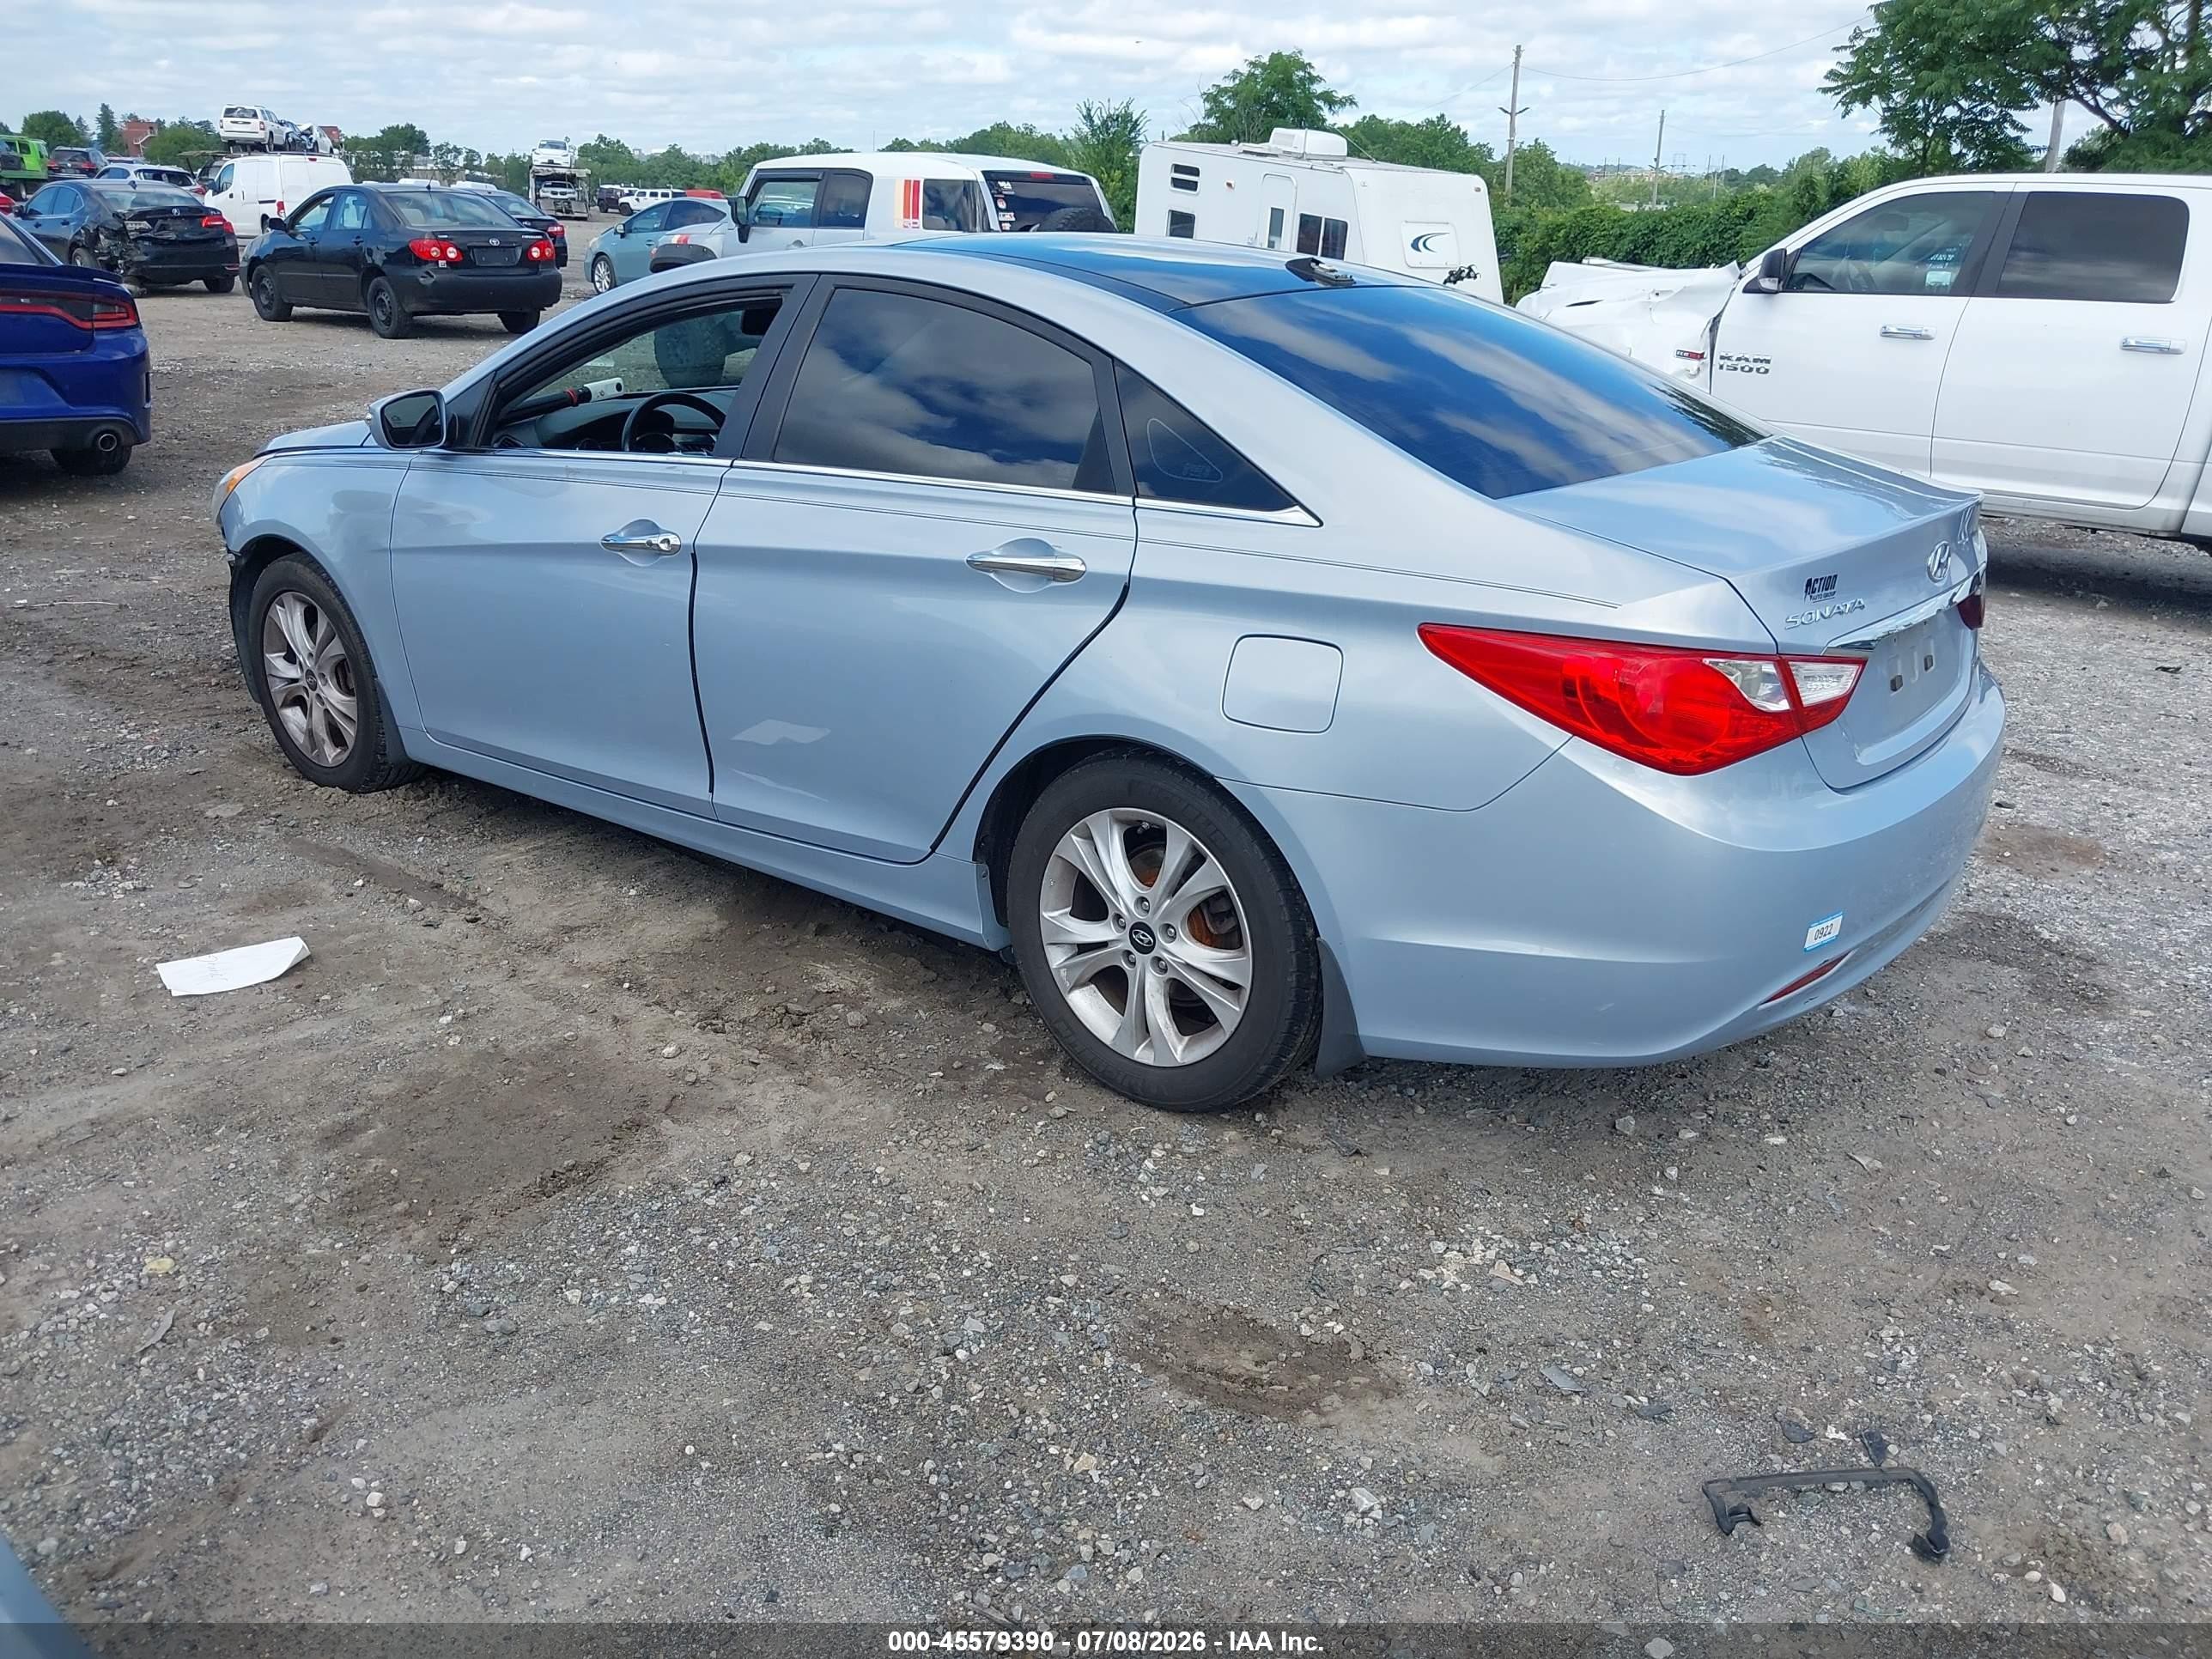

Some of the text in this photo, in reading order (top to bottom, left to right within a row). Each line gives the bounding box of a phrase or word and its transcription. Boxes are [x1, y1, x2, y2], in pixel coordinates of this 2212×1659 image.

[1718, 362, 1770, 374] 1500
[1804, 574, 1838, 598] ACTION
[1785, 599, 1865, 629] SONATA
[1814, 923, 1833, 940] 0922
